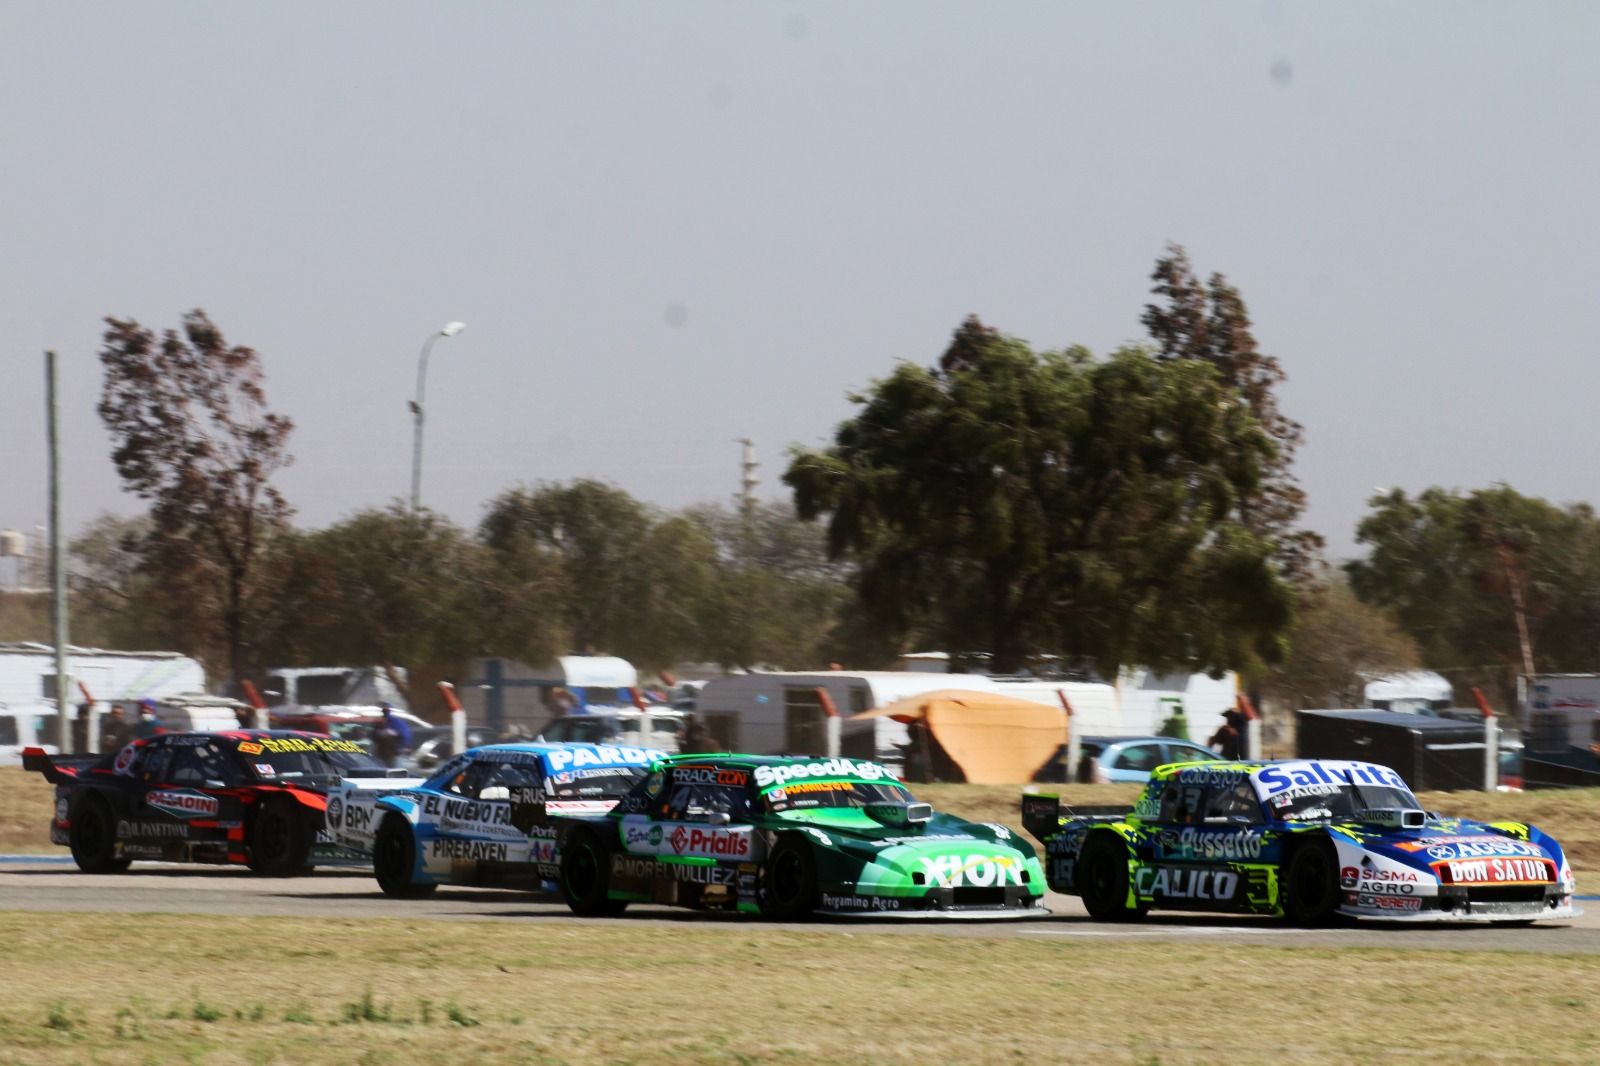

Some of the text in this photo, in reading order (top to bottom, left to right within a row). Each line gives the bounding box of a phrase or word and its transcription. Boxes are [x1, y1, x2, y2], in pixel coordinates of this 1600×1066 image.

[547, 746, 674, 771] PARDO
[753, 758, 900, 787] SpeedAgro
[1257, 762, 1408, 794] Salvita
[522, 787, 546, 805] RUS
[783, 780, 856, 795] HAMILTON
[147, 792, 218, 814] PALADINI
[424, 797, 441, 815] EL
[443, 799, 492, 822] NUEVO
[345, 804, 374, 830] BPN
[432, 839, 508, 861] PIRERAYEN
[689, 828, 749, 856] Prialis
[1180, 827, 1261, 859] Pussetto
[626, 858, 673, 880] MOREL
[673, 863, 736, 886] VULLIEZ
[916, 854, 1024, 888] XION
[1361, 868, 1418, 882] SIGMA
[1449, 859, 1549, 882] DON SATUR
[1133, 867, 1239, 900] CALICO
[1360, 881, 1414, 895] AGRO
[822, 893, 900, 910] Pergamino Agro
